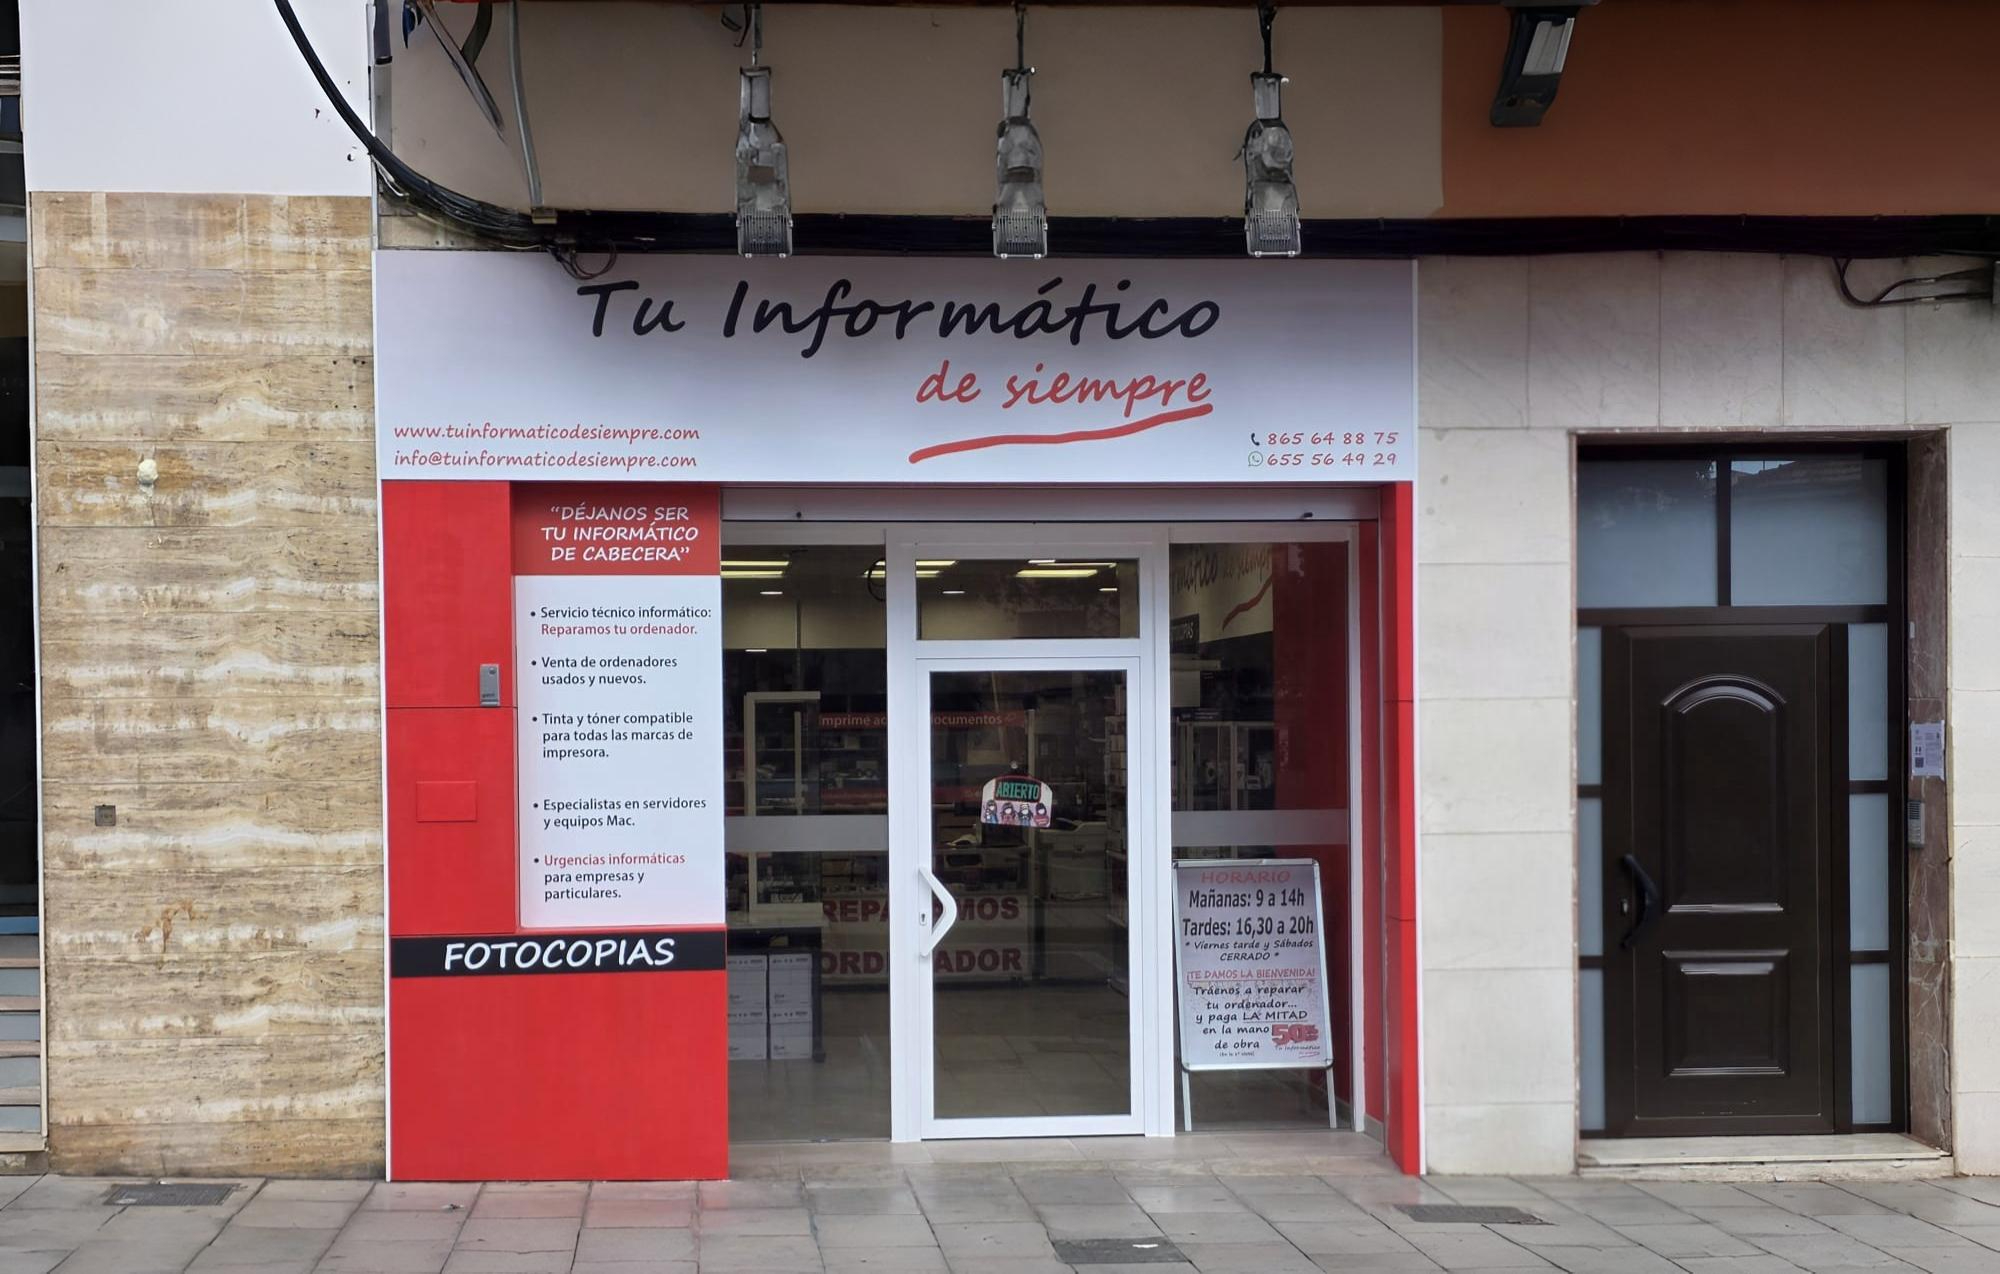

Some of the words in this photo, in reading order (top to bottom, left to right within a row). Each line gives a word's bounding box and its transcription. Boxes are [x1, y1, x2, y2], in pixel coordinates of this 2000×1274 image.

[577, 280, 685, 337] Tu
[724, 277, 1219, 358] Informático
[917, 360, 980, 402] de
[1002, 362, 1213, 417] siempre
[394, 423, 699, 444] www.tuinformaticodesiempre.com
[1268, 432, 1304, 446] 865
[1310, 432, 1335, 446] 64
[1343, 432, 1364, 446] 88
[1373, 432, 1399, 446] 75
[394, 450, 697, 471] info@tuinformaticodesiempre.com
[1267, 453, 1304, 467] 655
[1311, 453, 1335, 467] 56
[1341, 453, 1365, 467] 49
[1373, 453, 1397, 467] 29
[654, 507, 689, 520] SER
[541, 526, 566, 541] TU
[574, 522, 699, 541] INFORMÁTICO
[551, 547, 576, 561] DE
[541, 607, 589, 618] Servicio
[592, 606, 635, 618] técnico
[638, 606, 711, 618] informático:
[541, 624, 611, 637] Reparamos
[614, 625, 627, 634] tu
[630, 624, 697, 634] ordenador.
[542, 657, 577, 667] Venta
[581, 656, 596, 667] de
[599, 656, 677, 667] ordenadores
[542, 673, 585, 684] usados
[589, 676, 595, 687] y
[599, 675, 646, 684] nuevos.
[542, 713, 573, 724] Tinta
[577, 716, 584, 726] y
[587, 713, 620, 724] tóner
[623, 712, 693, 726] compatible
[934, 713, 1003, 725] ocumentos
[543, 732, 570, 744] para
[574, 730, 607, 741] todas
[611, 730, 628, 740] las
[631, 731, 674, 740] marcas
[677, 729, 693, 740] de
[543, 747, 609, 760] impresora.
[996, 782, 1039, 799] ABIERTO
[544, 799, 621, 812] Especialistas
[625, 801, 640, 810] en
[643, 797, 706, 808] servidores
[544, 819, 551, 830] y
[554, 816, 603, 829] equipos
[606, 816, 635, 826] Mac.
[544, 855, 605, 868] Urgencias
[609, 852, 686, 865] informáticas
[544, 872, 571, 884] para
[575, 872, 634, 884] empresas
[637, 873, 644, 883] y
[1201, 870, 1291, 884] HORARIO
[544, 887, 621, 901] particulares.
[1189, 889, 1251, 908] Mañanas:
[1256, 889, 1264, 907] 9
[1268, 893, 1275, 906] a
[1281, 888, 1305, 906] 14h
[1182, 917, 1231, 936] Tardes:
[1236, 916, 1273, 939] 16,30
[1277, 920, 1284, 934] a
[1289, 915, 1314, 934] 20h
[1194, 941, 1230, 950] Viernes
[1234, 940, 1260, 949] tarde
[1264, 942, 1270, 951] y
[1274, 938, 1313, 948] Sábados
[444, 938, 676, 971] FOTOCOPIAS
[1220, 951, 1271, 961] CERRADO
[1204, 969, 1238, 979] DAMOS
[1241, 969, 1253, 978] LA
[1256, 968, 1316, 978] BIENVENIDA!
[1193, 985, 1240, 995] Tráenos
[1245, 987, 1252, 995] a
[1257, 985, 1306, 997] reparar
[1207, 1001, 1219, 1010] tu
[1196, 1014, 1203, 1024] y
[1208, 1014, 1237, 1024] paga
[1243, 1011, 1260, 1020] LA
[1265, 1010, 1308, 1020] MITAD
[1203, 1026, 1217, 1035] en
[1222, 1025, 1232, 1034] la
[1237, 1026, 1270, 1034] mano
[1215, 1040, 1229, 1049] de
[1233, 1039, 1260, 1049] obra
